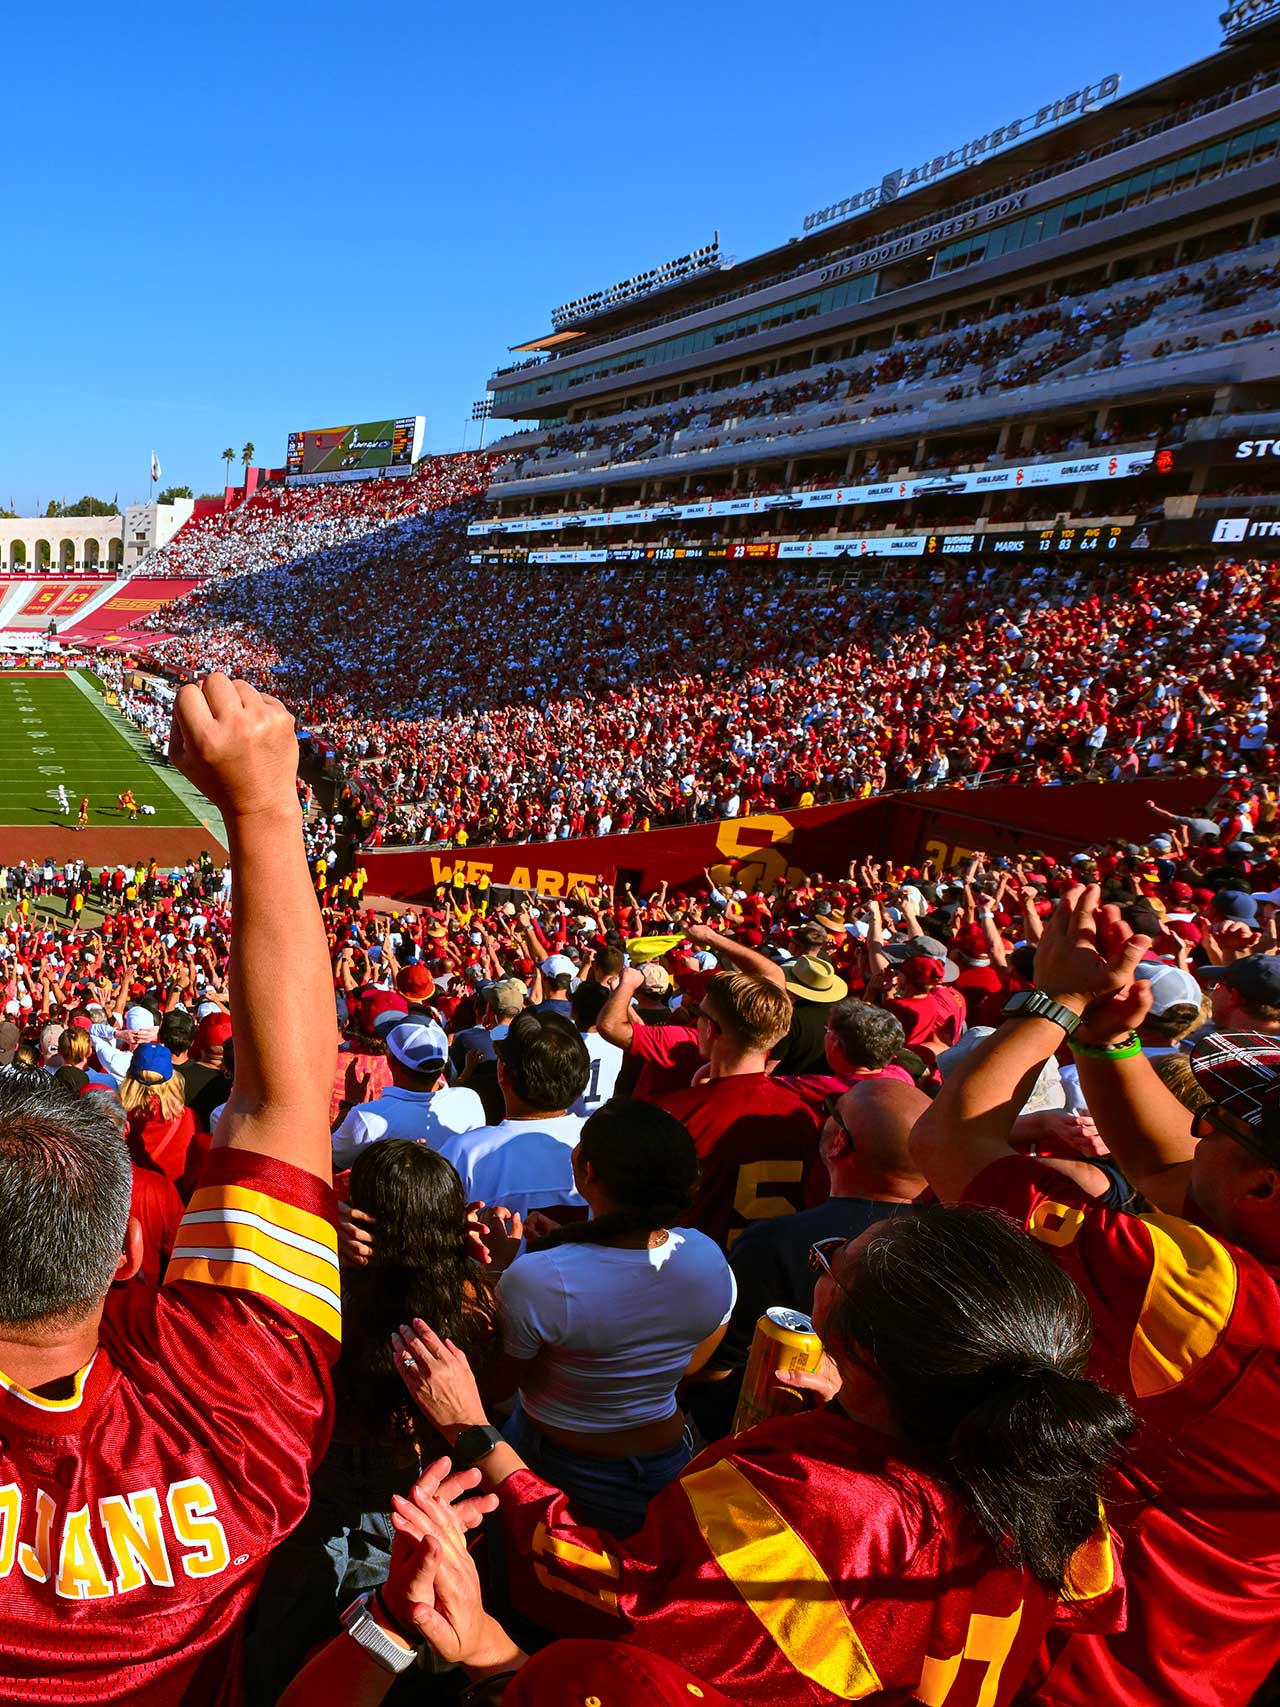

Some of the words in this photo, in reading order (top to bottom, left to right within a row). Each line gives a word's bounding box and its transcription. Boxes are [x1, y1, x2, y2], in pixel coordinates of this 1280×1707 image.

[803, 188, 878, 230] UNITED
[899, 119, 1023, 187] AIRLINES
[1033, 72, 1119, 128] FIELD
[819, 257, 852, 283] OTIS
[858, 239, 913, 268] BOOTH
[920, 216, 975, 245] PRESS
[986, 193, 1026, 221] BOX
[1040, 530, 1054, 539] ATT
[1061, 529, 1075, 538] YDS
[1084, 528, 1100, 537] AVG
[1110, 527, 1121, 536] TD
[943, 536, 975, 544] RUSHING
[994, 541, 1024, 552] MARKS
[1039, 540, 1051, 551] 13
[1058, 539, 1072, 550] 83
[1080, 538, 1097, 549] 6.4
[1108, 537, 1117, 549] 0
[631, 551, 640, 560] 20
[655, 549, 675, 559] 11:35
[734, 546, 745, 558] 23
[941, 544, 973, 553] LEADERS
[38, 593, 55, 602] 5
[66, 593, 89, 602] 13
[430, 856, 492, 888] WE
[508, 866, 597, 898] ARE
